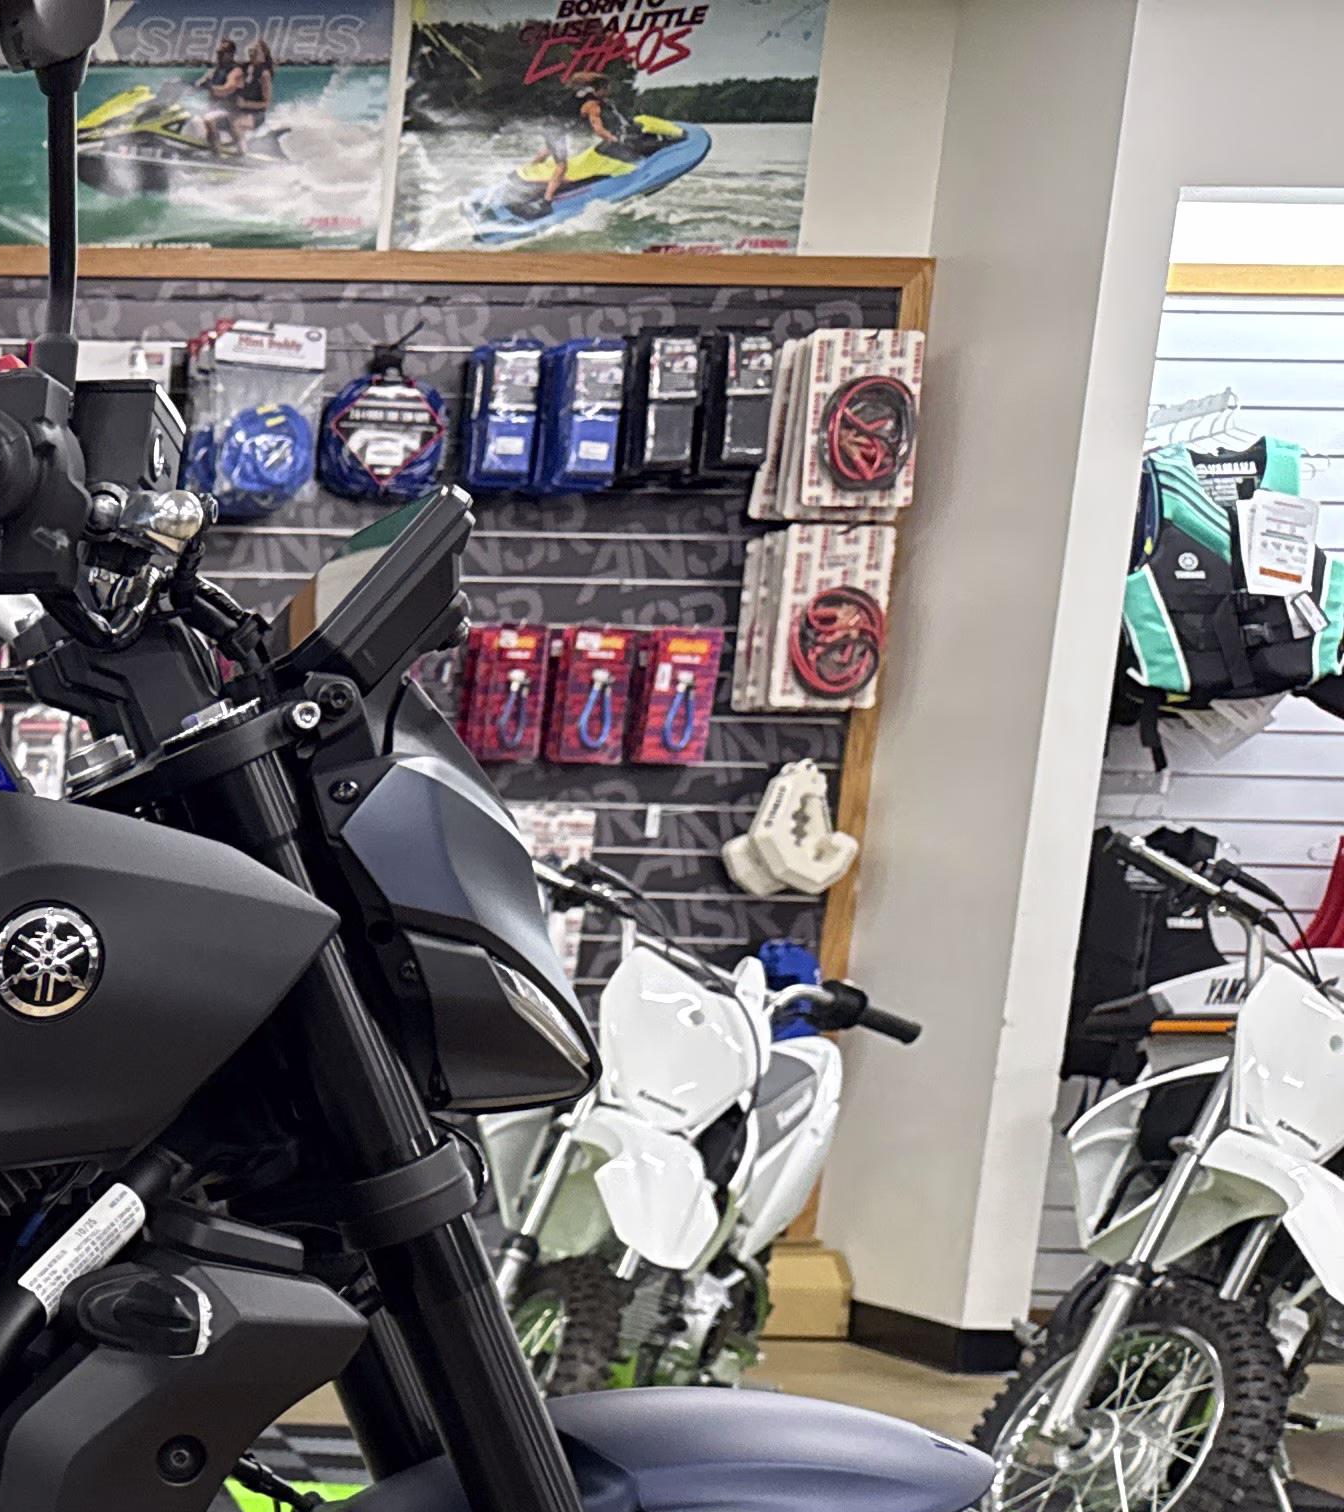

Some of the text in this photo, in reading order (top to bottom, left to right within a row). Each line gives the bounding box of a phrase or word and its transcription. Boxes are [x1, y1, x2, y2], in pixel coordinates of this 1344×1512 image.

[518, 5, 711, 43] CAUSE A LITTLE
[523, 26, 693, 85] CHAOS
[1204, 977, 1250, 1006] YAMA
[74, 1217, 98, 1239] 10/25
